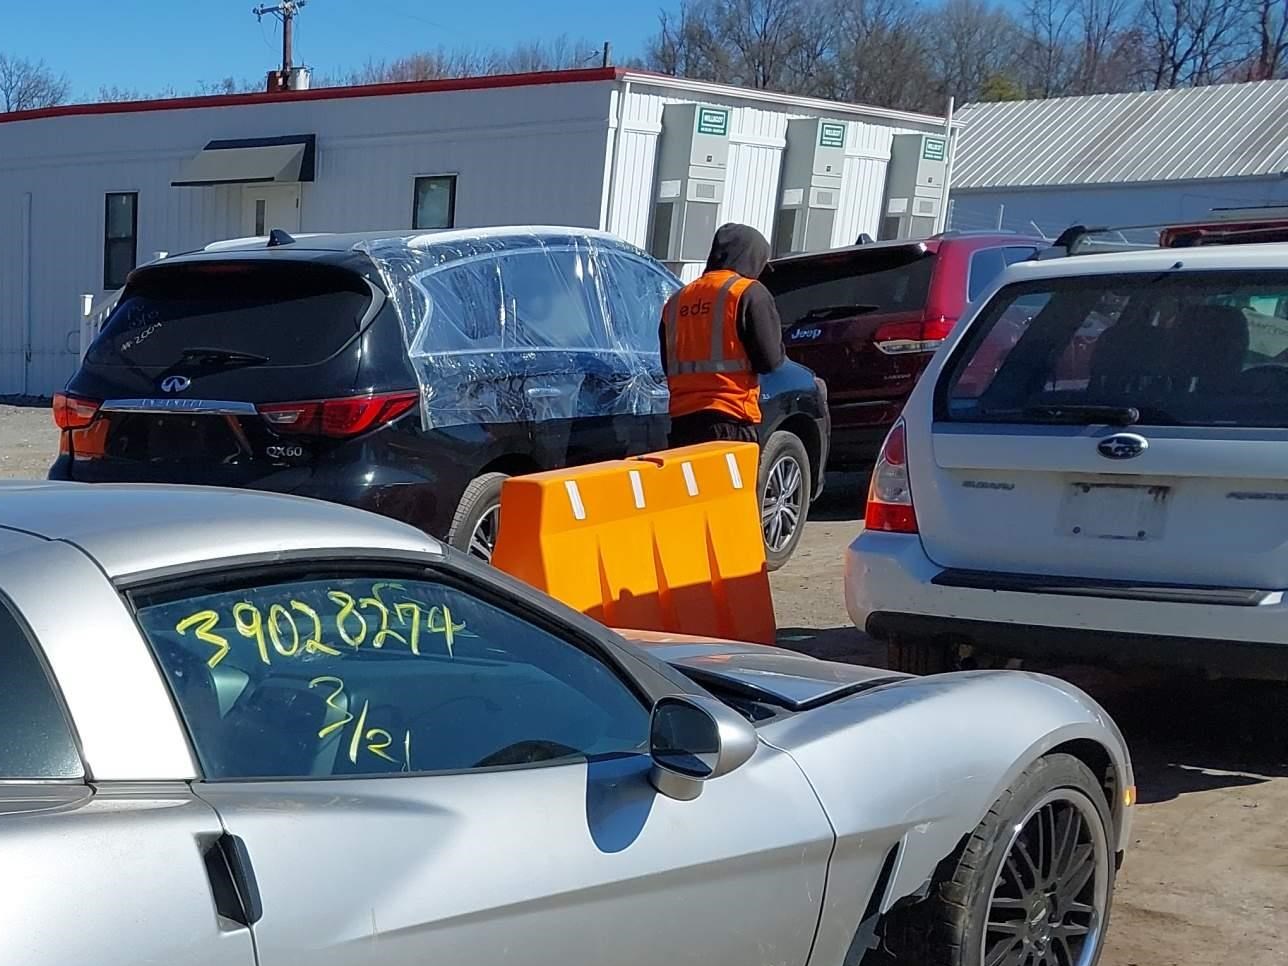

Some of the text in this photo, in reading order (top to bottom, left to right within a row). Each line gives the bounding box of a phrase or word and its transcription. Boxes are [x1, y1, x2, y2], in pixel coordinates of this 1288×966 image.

[679, 296, 712, 317] eds
[791, 328, 822, 340] Jeep
[266, 446, 303, 458] QX60
[308, 676, 412, 772] 3/21
